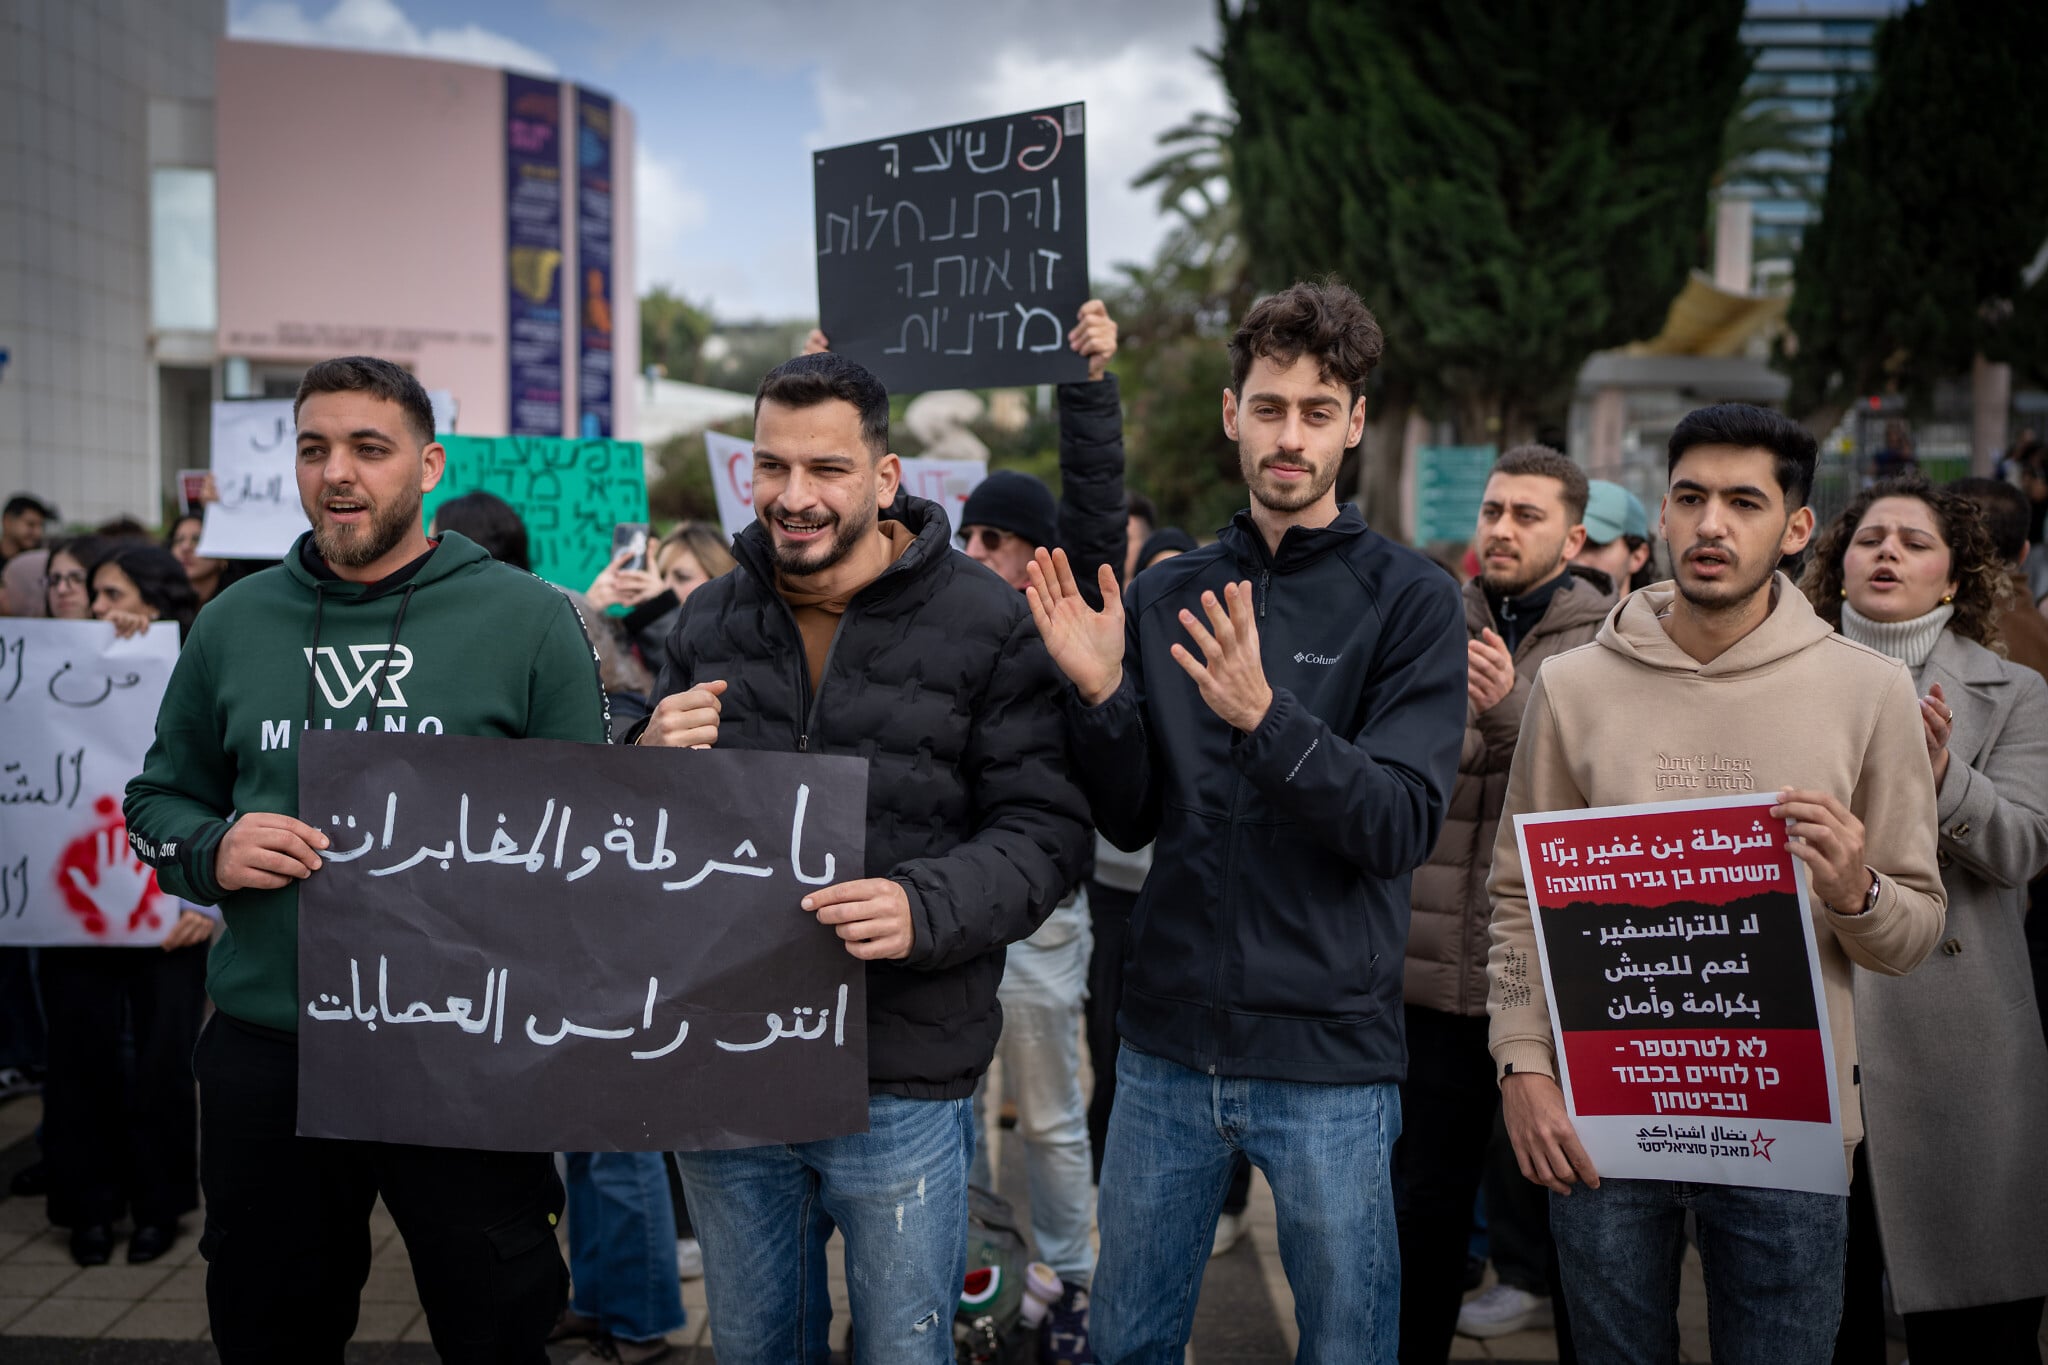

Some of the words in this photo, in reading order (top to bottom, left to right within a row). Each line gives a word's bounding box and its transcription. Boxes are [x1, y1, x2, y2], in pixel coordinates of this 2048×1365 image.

[879, 115, 1062, 178] פשיעה
[818, 177, 1060, 256] והתנחלות
[895, 249, 1013, 298] אותה
[884, 302, 1062, 354] מדיניות
[1650, 835, 1684, 859] بن
[1691, 820, 1773, 855] شرطة
[1586, 834, 1644, 865] غفير
[1545, 873, 1616, 894] החוצה!
[1621, 870, 1667, 888] גביר
[1672, 868, 1694, 890] בן
[1699, 863, 1781, 884] משטרת
[1599, 914, 1730, 946] للترانسفير
[1739, 913, 1760, 934] لا
[1604, 952, 1693, 983] للعيش
[1701, 952, 1750, 984] نعم
[306, 953, 508, 1044] العصابات
[1607, 986, 1675, 1020] وأمان
[1682, 992, 1761, 1020] بكرامة
[1630, 1036, 1730, 1058] לטרנספר
[1736, 1036, 1767, 1058] לא
[1612, 1066, 1680, 1083] בכבוד
[1685, 1063, 1749, 1085] לחיים
[1755, 1067, 1780, 1090] כן
[1651, 1091, 1748, 1113] ובביטחון
[1637, 1140, 1708, 1155] סוציאליסטי
[1710, 1144, 1750, 1158] מאבק
